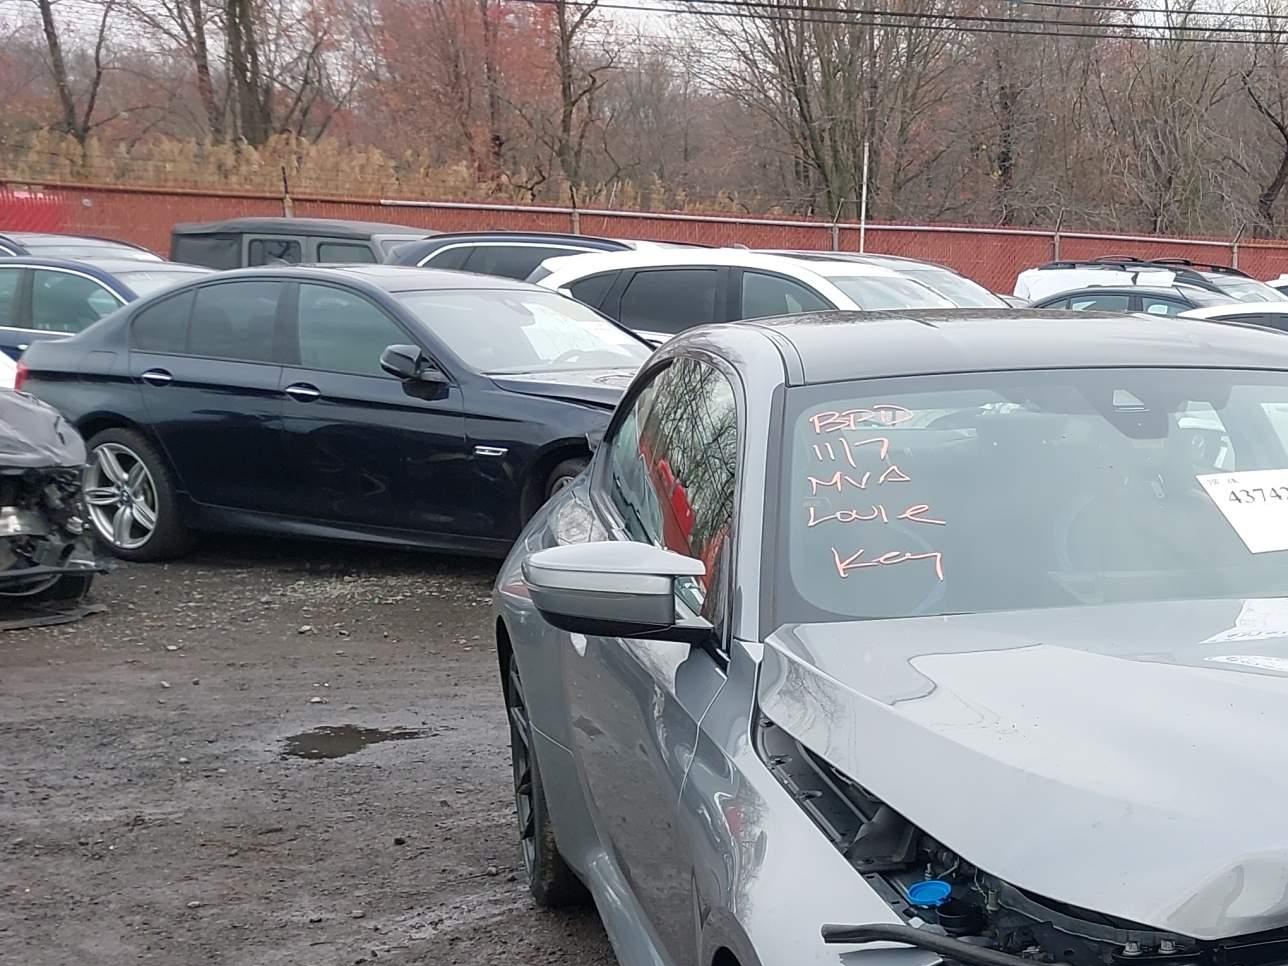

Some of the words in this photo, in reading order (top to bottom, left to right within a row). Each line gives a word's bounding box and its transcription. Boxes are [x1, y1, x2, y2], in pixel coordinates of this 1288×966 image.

[813, 437, 889, 468] 11/7
[807, 465, 911, 495] MVA
[831, 547, 944, 582] Key
